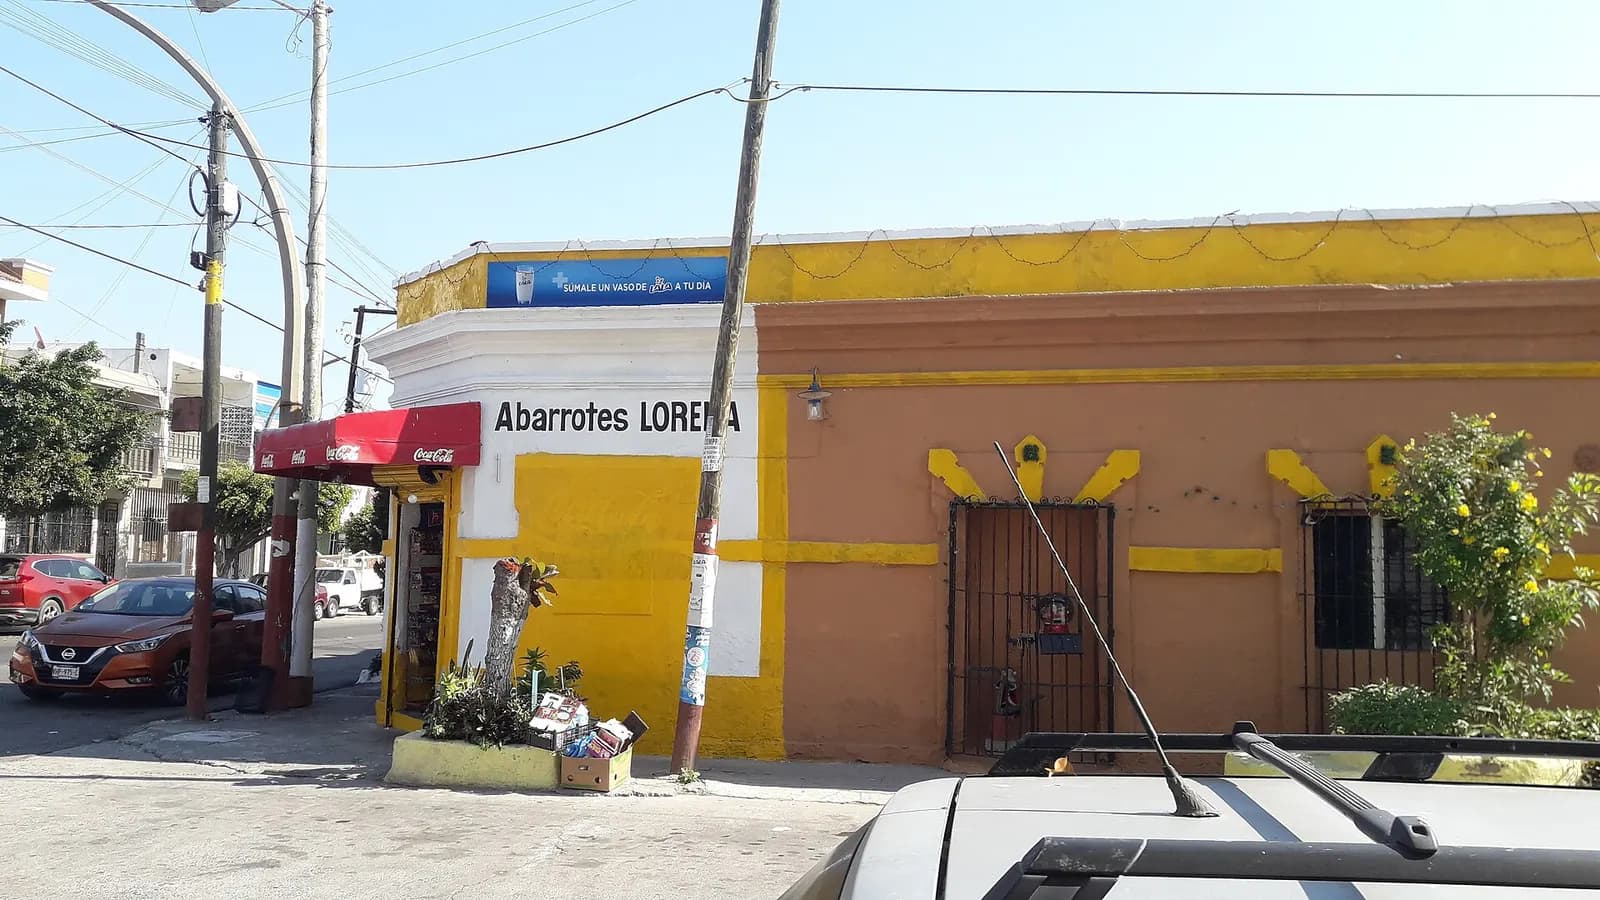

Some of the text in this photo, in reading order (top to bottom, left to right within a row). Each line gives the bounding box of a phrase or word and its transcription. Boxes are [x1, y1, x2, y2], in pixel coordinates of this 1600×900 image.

[563, 282, 596, 292] SÚMALE
[598, 283, 610, 291] UN
[612, 283, 635, 291] VASO
[636, 283, 647, 291] DE
[683, 282, 695, 290] TU
[494, 401, 628, 432] Abarrotes
